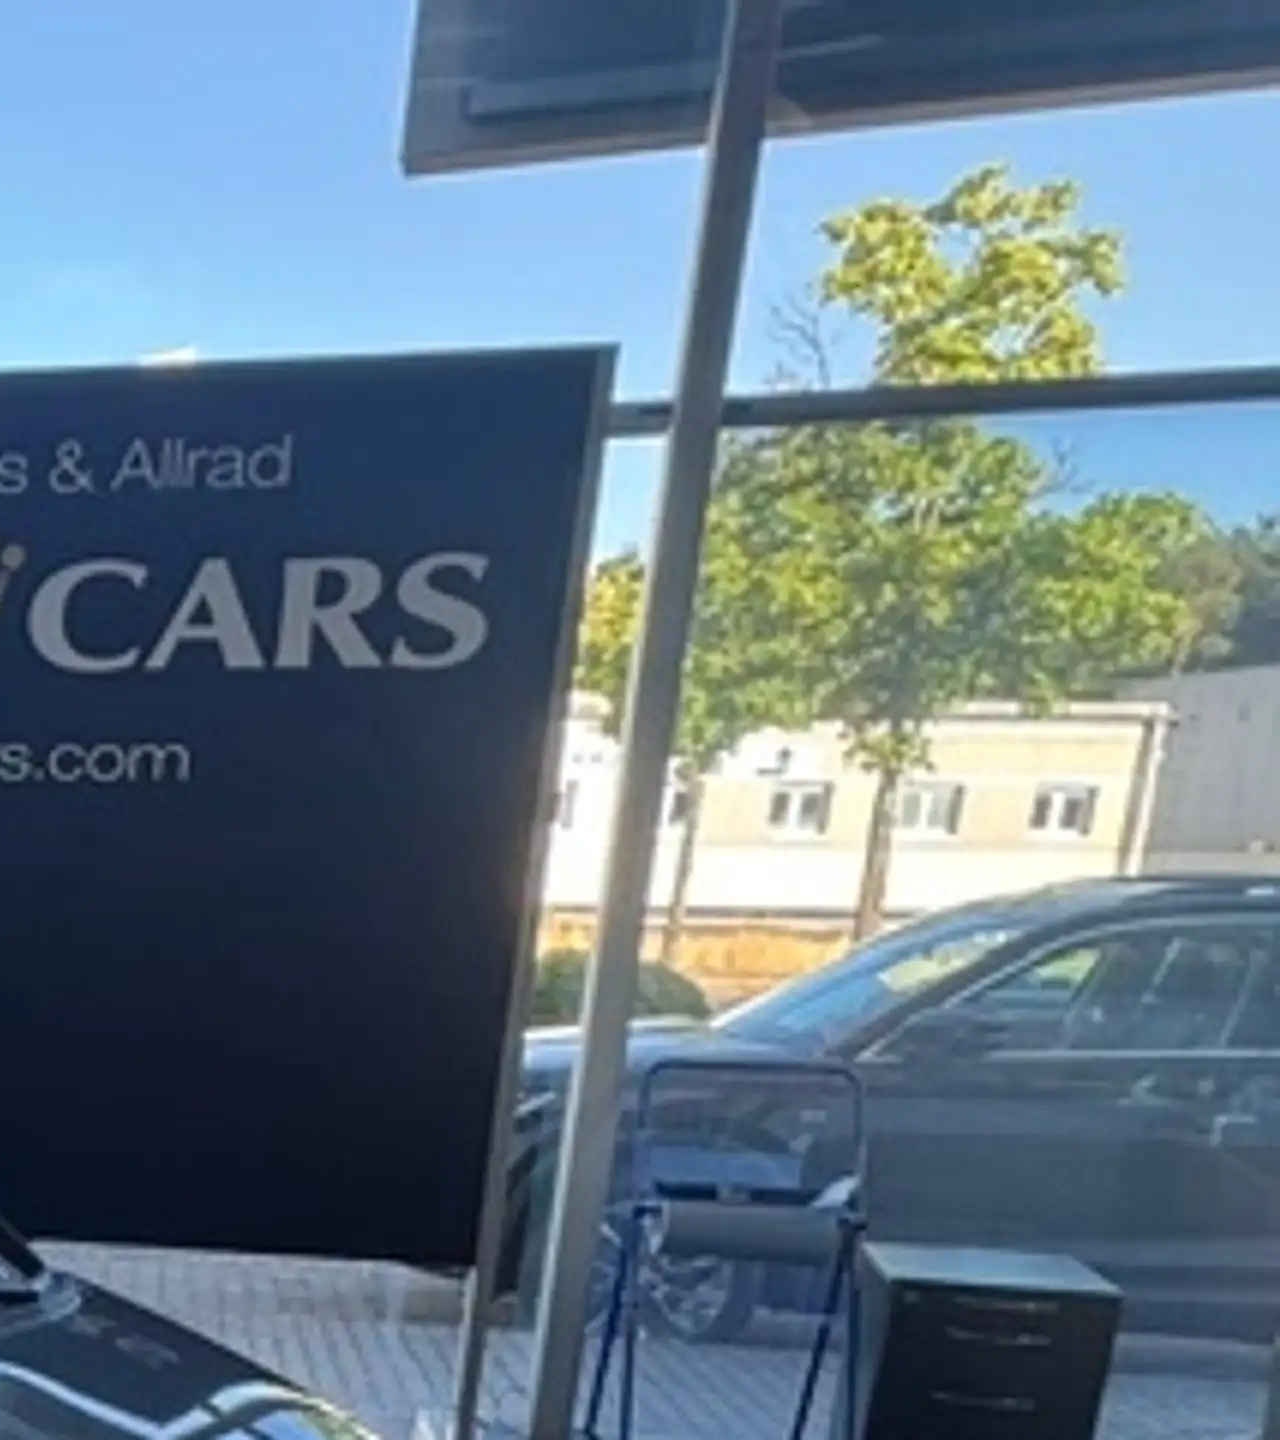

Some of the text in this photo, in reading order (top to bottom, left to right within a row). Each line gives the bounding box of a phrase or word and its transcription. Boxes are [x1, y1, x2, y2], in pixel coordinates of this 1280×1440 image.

[48, 439, 95, 495] &
[109, 434, 296, 491] Allrad
[26, 551, 490, 673] CARS
